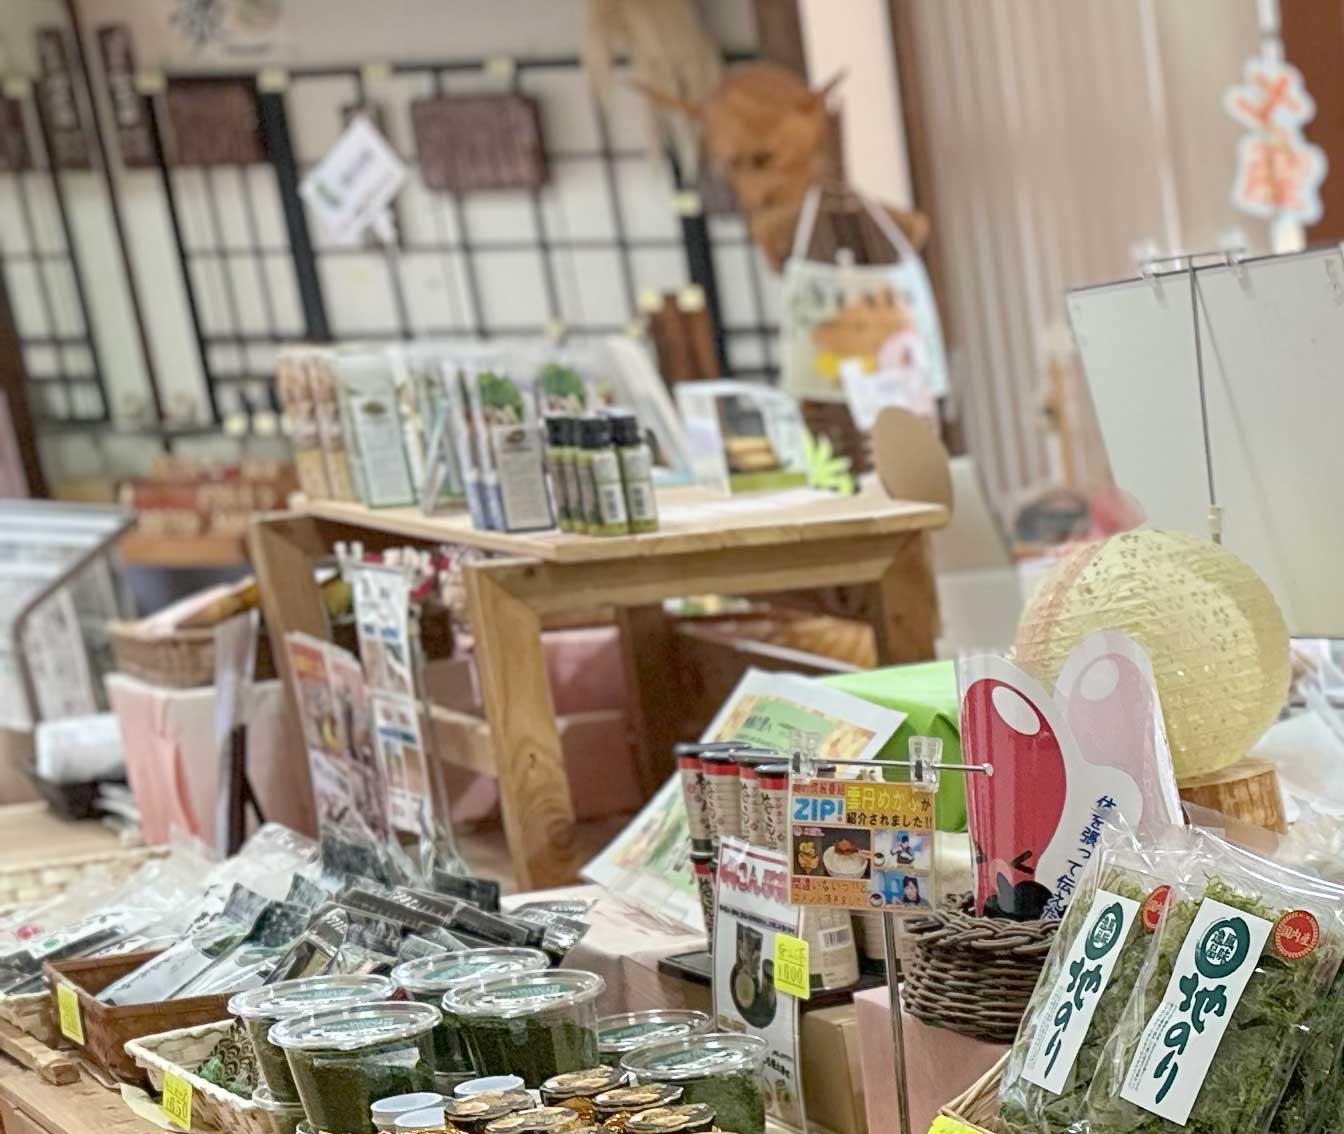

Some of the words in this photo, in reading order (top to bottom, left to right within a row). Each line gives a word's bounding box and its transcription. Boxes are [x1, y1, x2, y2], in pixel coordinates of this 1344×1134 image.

[1044, 956, 1103, 1079] 地のり
[1153, 972, 1228, 1105] 地のり
